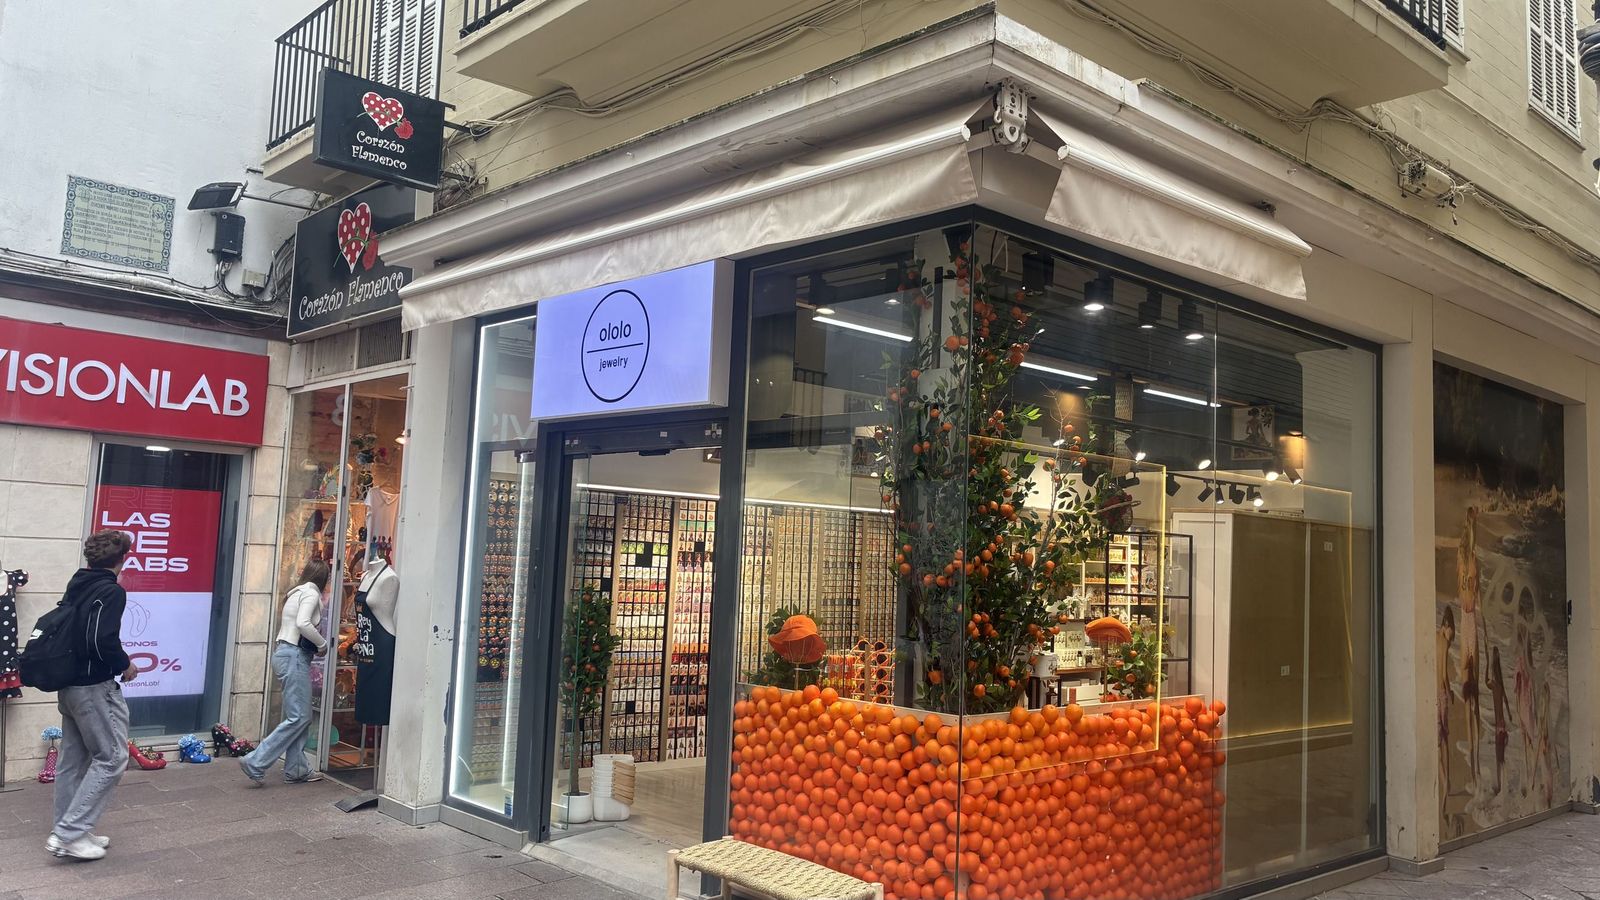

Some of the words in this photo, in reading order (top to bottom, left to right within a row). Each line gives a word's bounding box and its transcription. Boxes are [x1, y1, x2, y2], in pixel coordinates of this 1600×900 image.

[356, 131, 405, 154] Corazón
[352, 145, 407, 170] Flamenco
[299, 287, 344, 320] Corazón
[346, 272, 404, 307] Flamenco
[600, 321, 632, 342] ololo
[599, 355, 629, 371] jewelry
[101, 510, 171, 529] LAS
[121, 556, 189, 573] ABS
